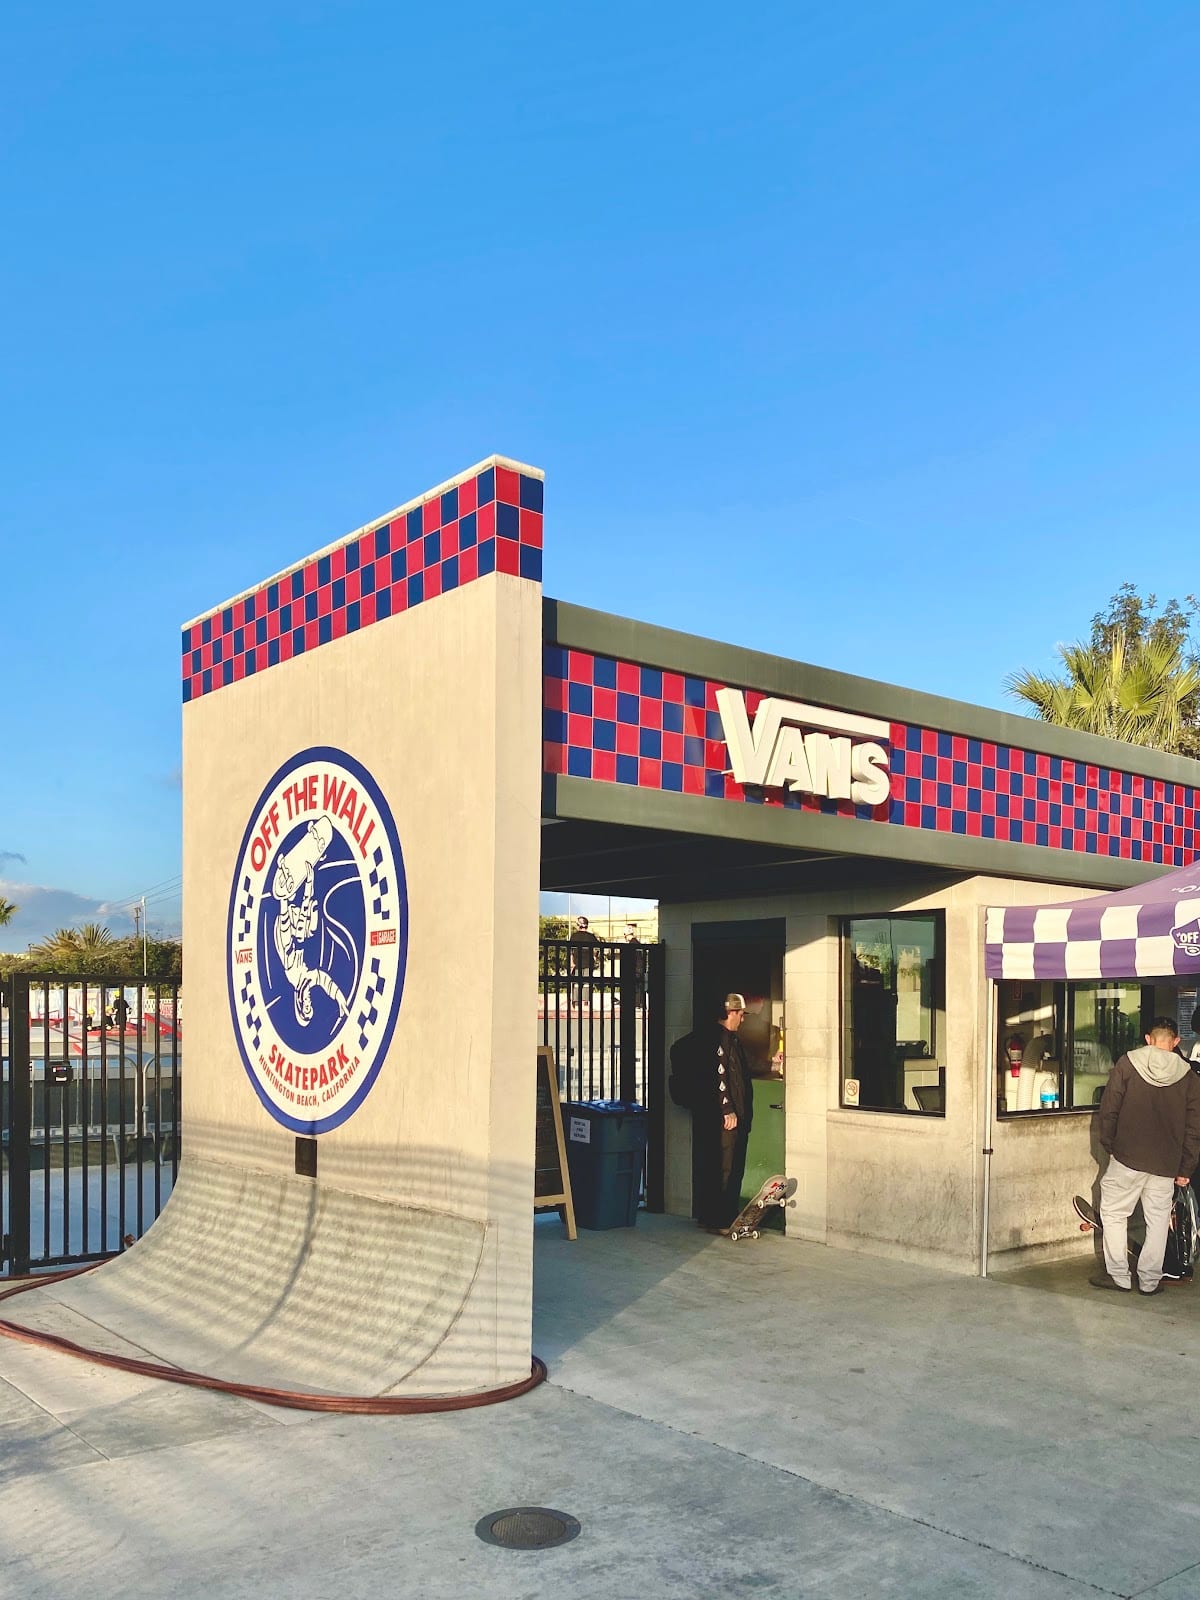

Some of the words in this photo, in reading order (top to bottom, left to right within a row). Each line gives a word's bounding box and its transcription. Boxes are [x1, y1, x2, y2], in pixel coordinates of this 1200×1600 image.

[715, 687, 890, 806] VANS
[250, 801, 280, 873] OFF
[282, 774, 319, 821] THE
[323, 774, 376, 860] WALL
[234, 948, 253, 965] VANS
[259, 1054, 295, 1103] HUNTINGTON
[296, 1094, 320, 1107] BEACH,
[321, 1056, 360, 1103] CALIFORNIA
[268, 1043, 350, 1090] SKATEPARK
